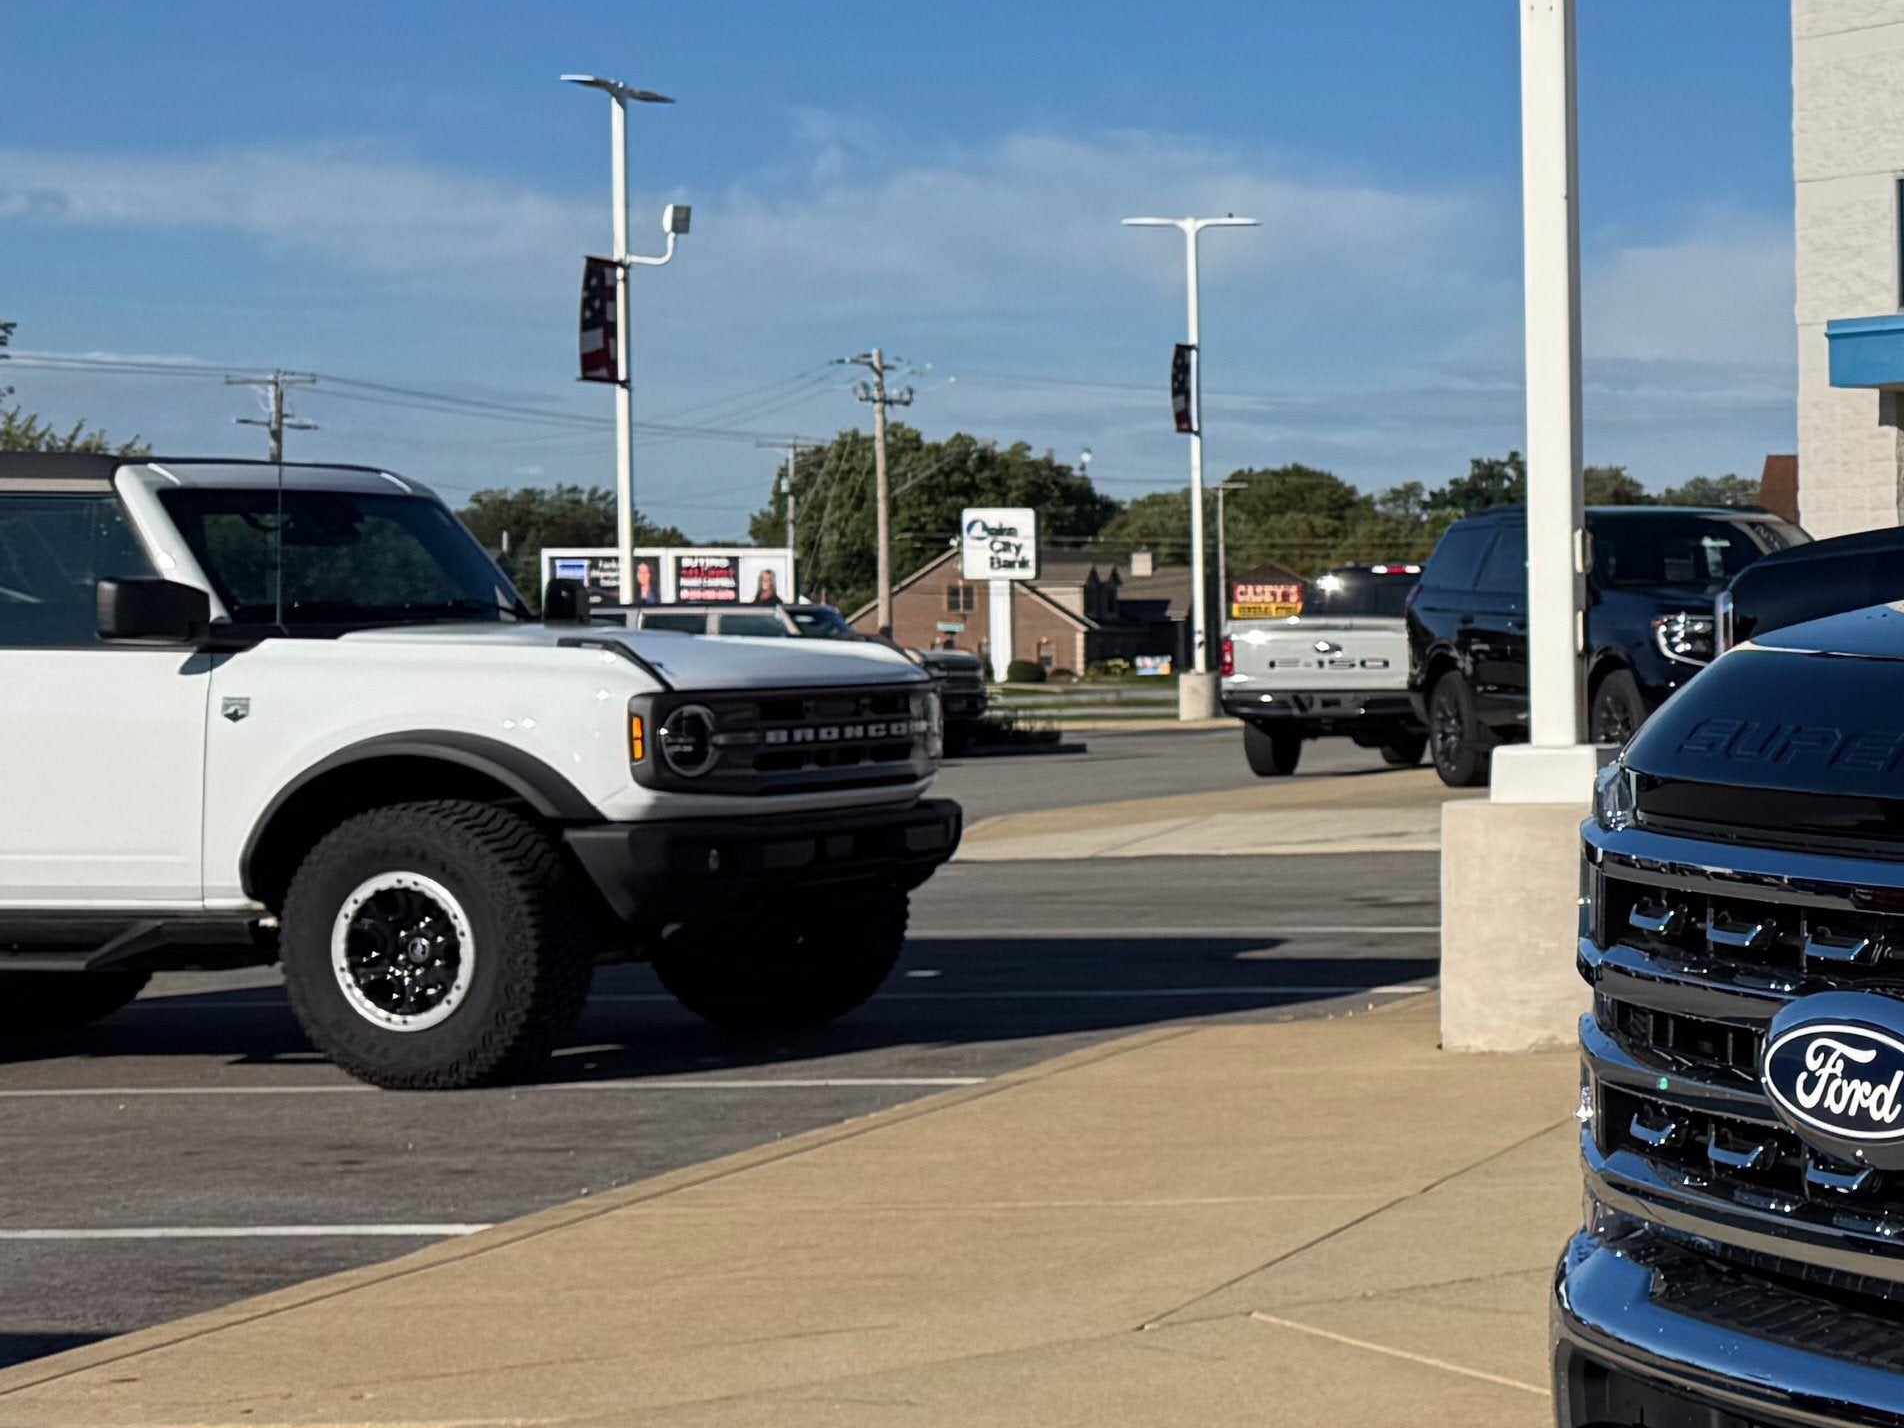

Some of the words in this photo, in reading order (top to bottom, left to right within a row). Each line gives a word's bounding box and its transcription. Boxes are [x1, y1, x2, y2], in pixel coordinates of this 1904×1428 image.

[989, 538, 1022, 557] City
[989, 555, 1030, 571] Bank
[1236, 584, 1300, 604] CASEY'S
[765, 723, 910, 744] BRONCO
[1796, 1038, 1904, 1124] Ford
